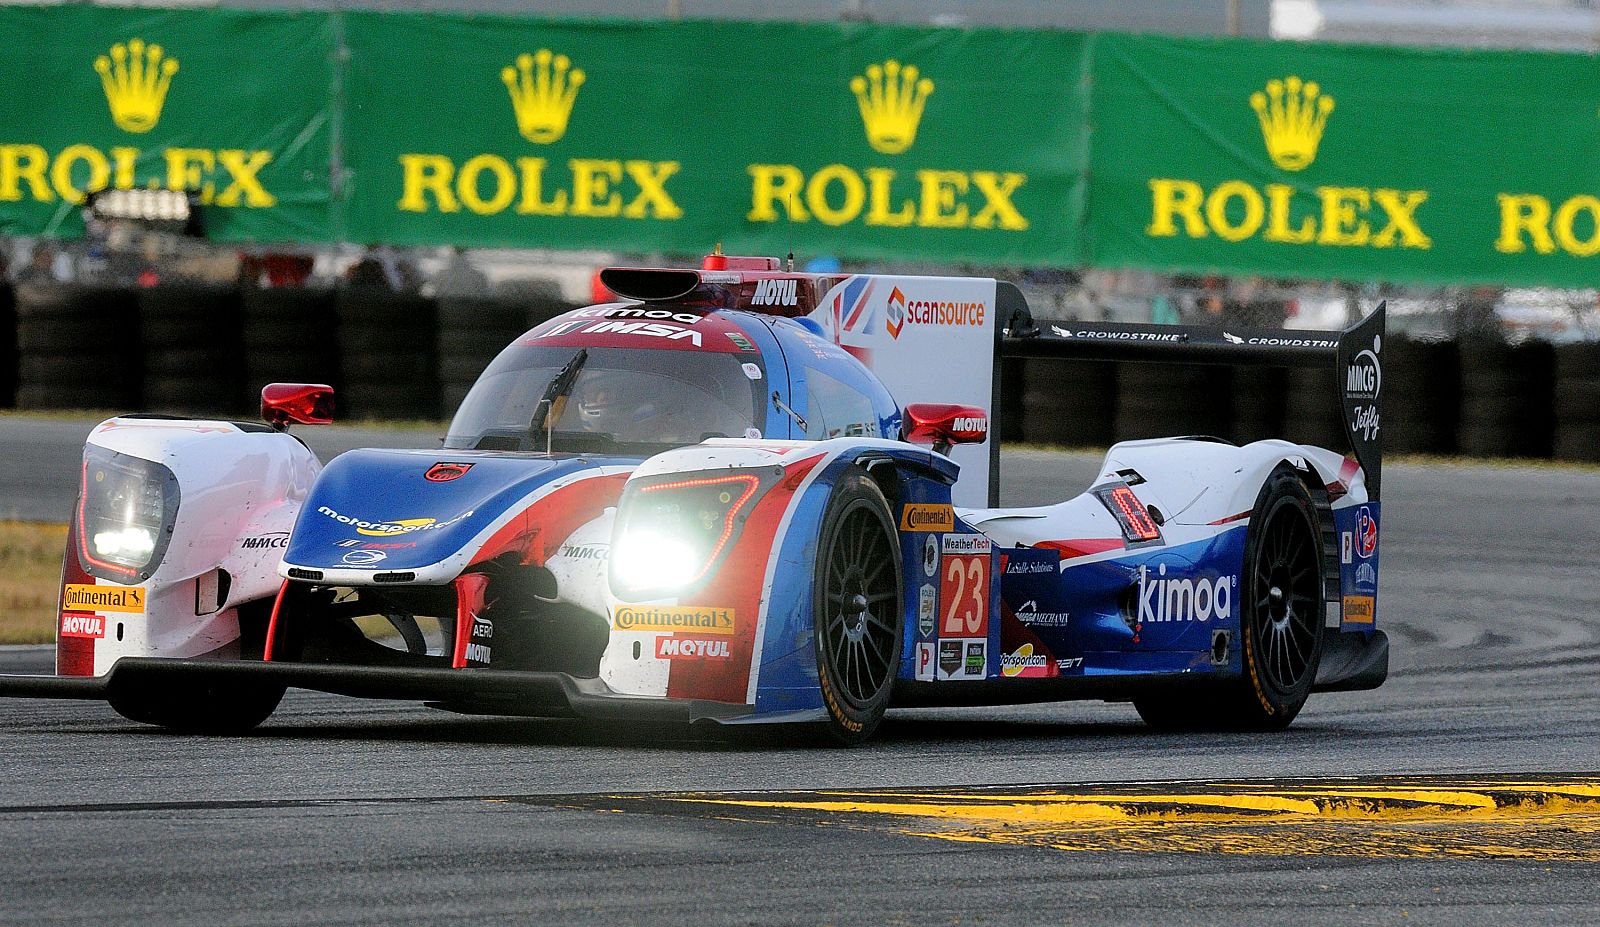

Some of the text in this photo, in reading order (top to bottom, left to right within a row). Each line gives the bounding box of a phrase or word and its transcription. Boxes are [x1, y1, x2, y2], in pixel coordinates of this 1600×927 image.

[399, 154, 683, 219] ROLEX
[748, 164, 1029, 231] ROLEX
[1147, 178, 1431, 249] ROLEX
[751, 280, 797, 306] MOTUL
[570, 306, 703, 324] kimoa
[907, 301, 985, 326] scansource
[581, 321, 702, 347] IMSA
[1077, 331, 1180, 341] CROWDSTRIKE
[1347, 365, 1374, 391] MMCG
[953, 417, 987, 432] MOTUL
[1352, 404, 1380, 441] Jetfly
[317, 506, 474, 533] motorsport.com
[906, 507, 946, 528] Continental
[945, 538, 990, 550] WeatherTech
[64, 587, 127, 608] Continental
[945, 558, 984, 633] 23
[62, 616, 102, 634] MOTUL
[615, 608, 717, 629] Continental
[659, 639, 730, 657] MOTUL
